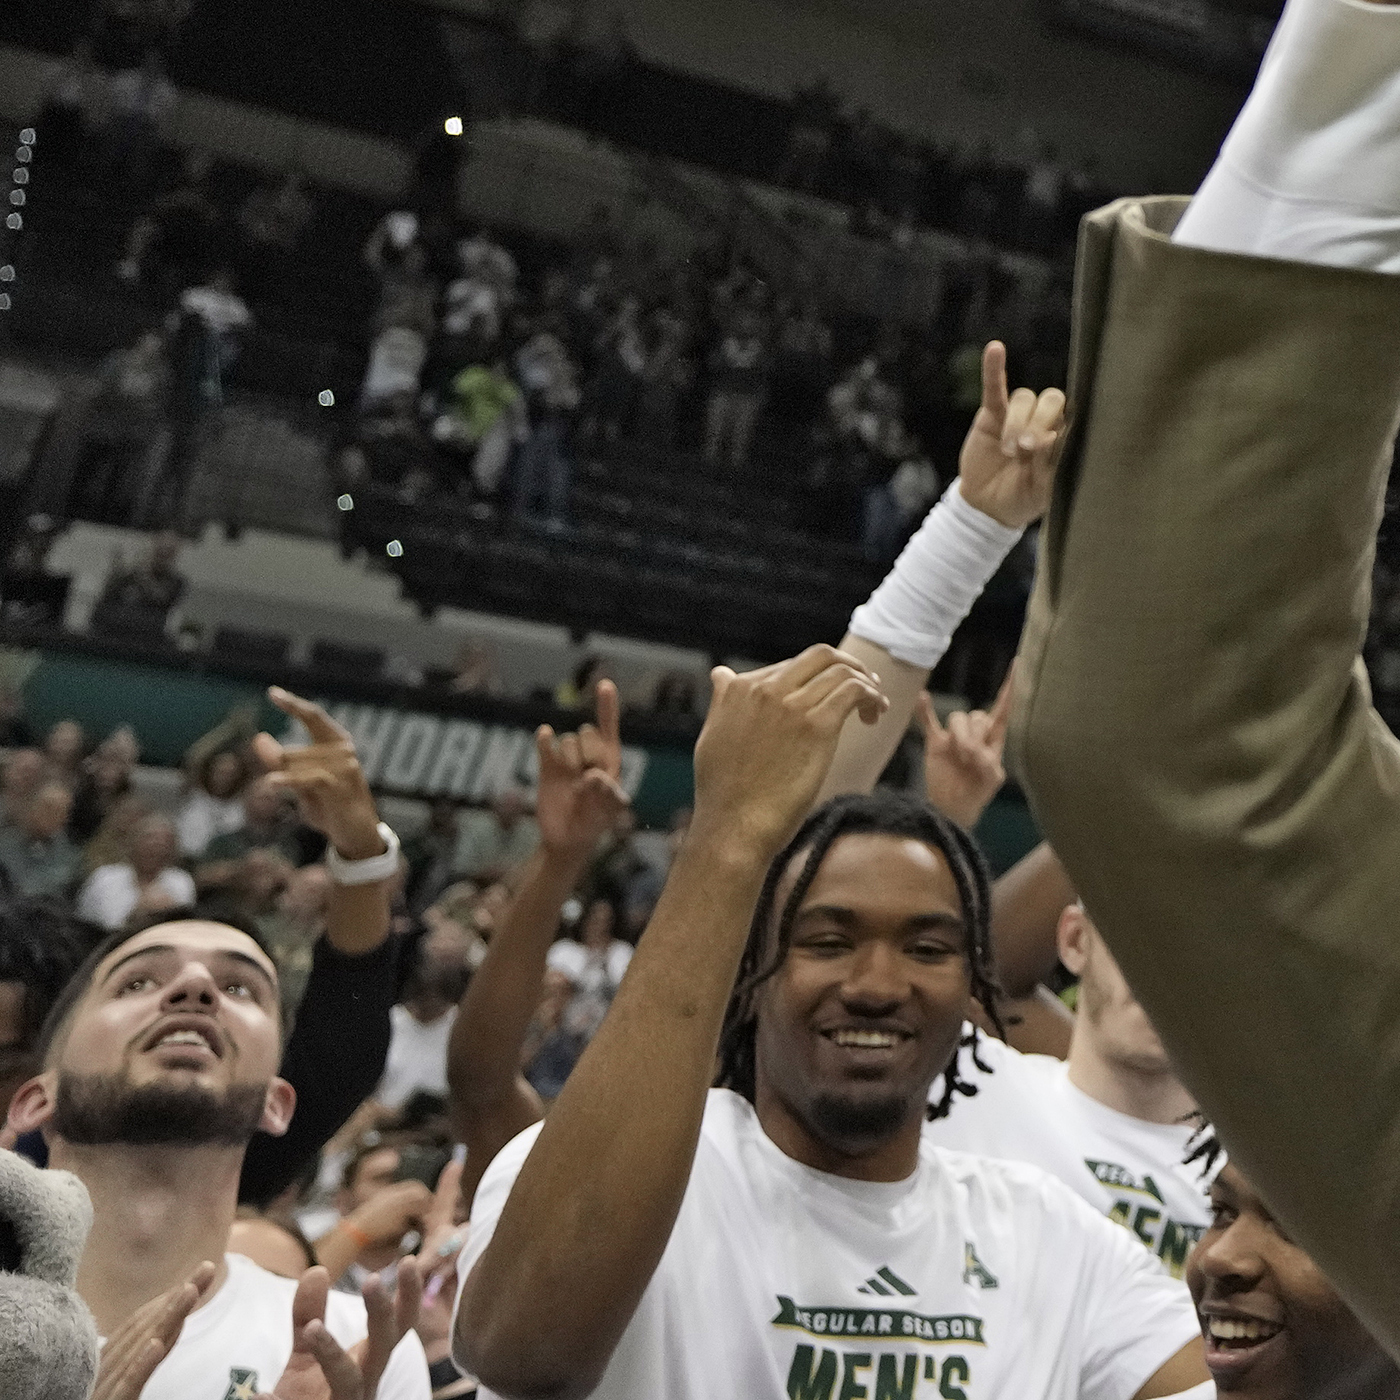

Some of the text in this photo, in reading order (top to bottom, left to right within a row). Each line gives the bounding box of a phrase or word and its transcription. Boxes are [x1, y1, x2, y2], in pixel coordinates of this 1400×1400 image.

[796, 1310, 976, 1339] EGULAR SEASON
[787, 1343, 970, 1400] MEN'S
